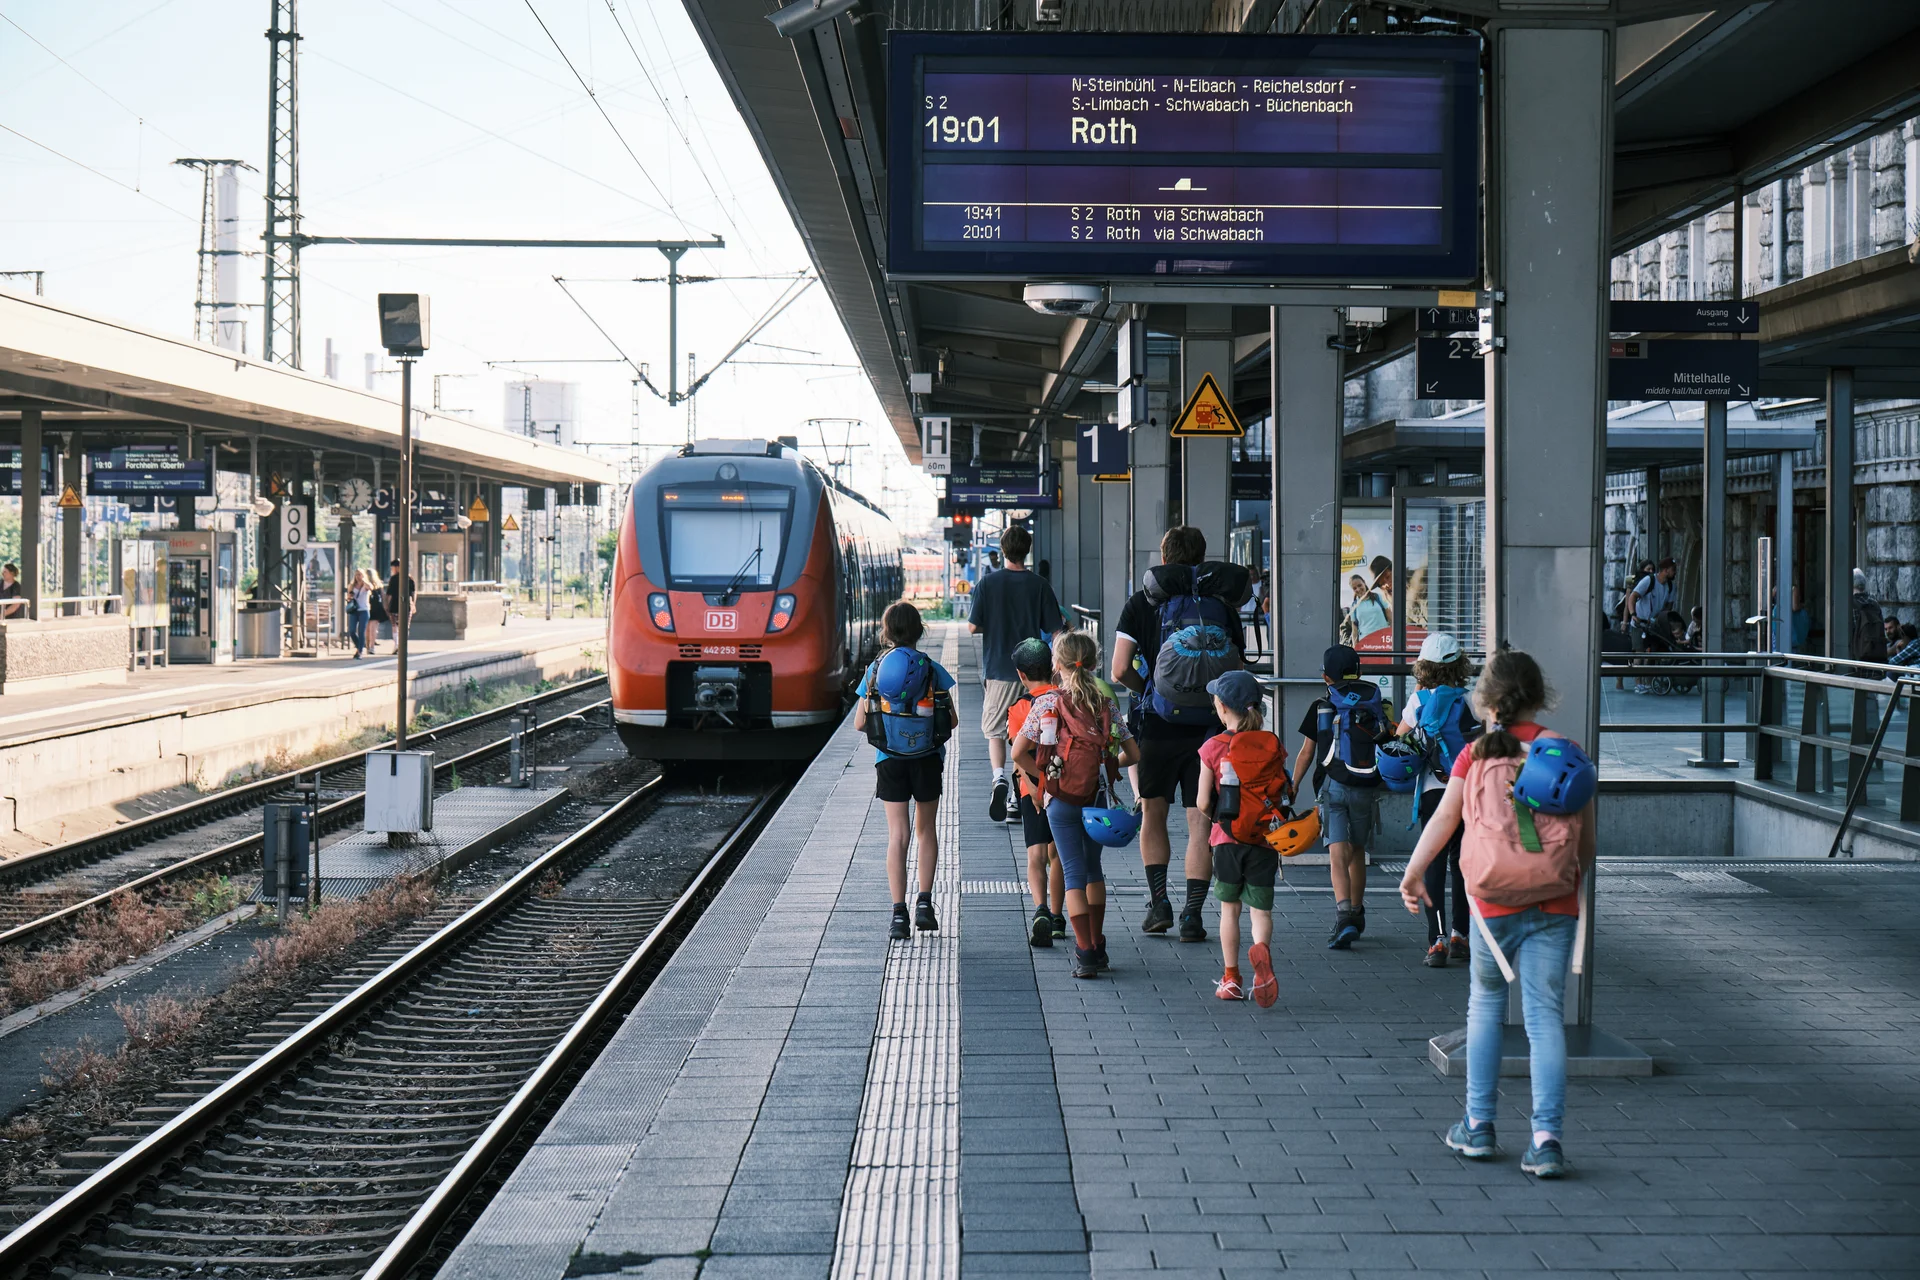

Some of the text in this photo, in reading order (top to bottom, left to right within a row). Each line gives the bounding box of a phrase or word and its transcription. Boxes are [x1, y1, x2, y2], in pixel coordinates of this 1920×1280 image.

[1072, 78, 1156, 93] N-Steinbühl
[1173, 79, 1235, 93] N-Eibach
[1253, 80, 1344, 94] Reichelsdorf
[925, 96, 948, 110] S 2
[1072, 97, 1149, 111] S.-Limbach
[1166, 98, 1249, 112] Schwabach
[1266, 98, 1353, 113] Büchenbach
[925, 116, 1137, 144] 19:01 Roth
[964, 207, 1264, 222] 19:41 S 2 Roth via Schwabach
[963, 226, 1264, 241] 20:01 S 2 Roth via Schwabach
[1697, 308, 1729, 319] Ausgang
[1673, 372, 1731, 384] Mittelhalle
[1645, 386, 1731, 396] middle hall/hall central
[926, 421, 947, 455] H
[1083, 425, 1100, 463] 1
[125, 461, 159, 469] Forchheim
[928, 462, 946, 470] 60m
[975, 531, 985, 546] H
[708, 613, 734, 628] DB
[703, 646, 736, 655] 442 253
